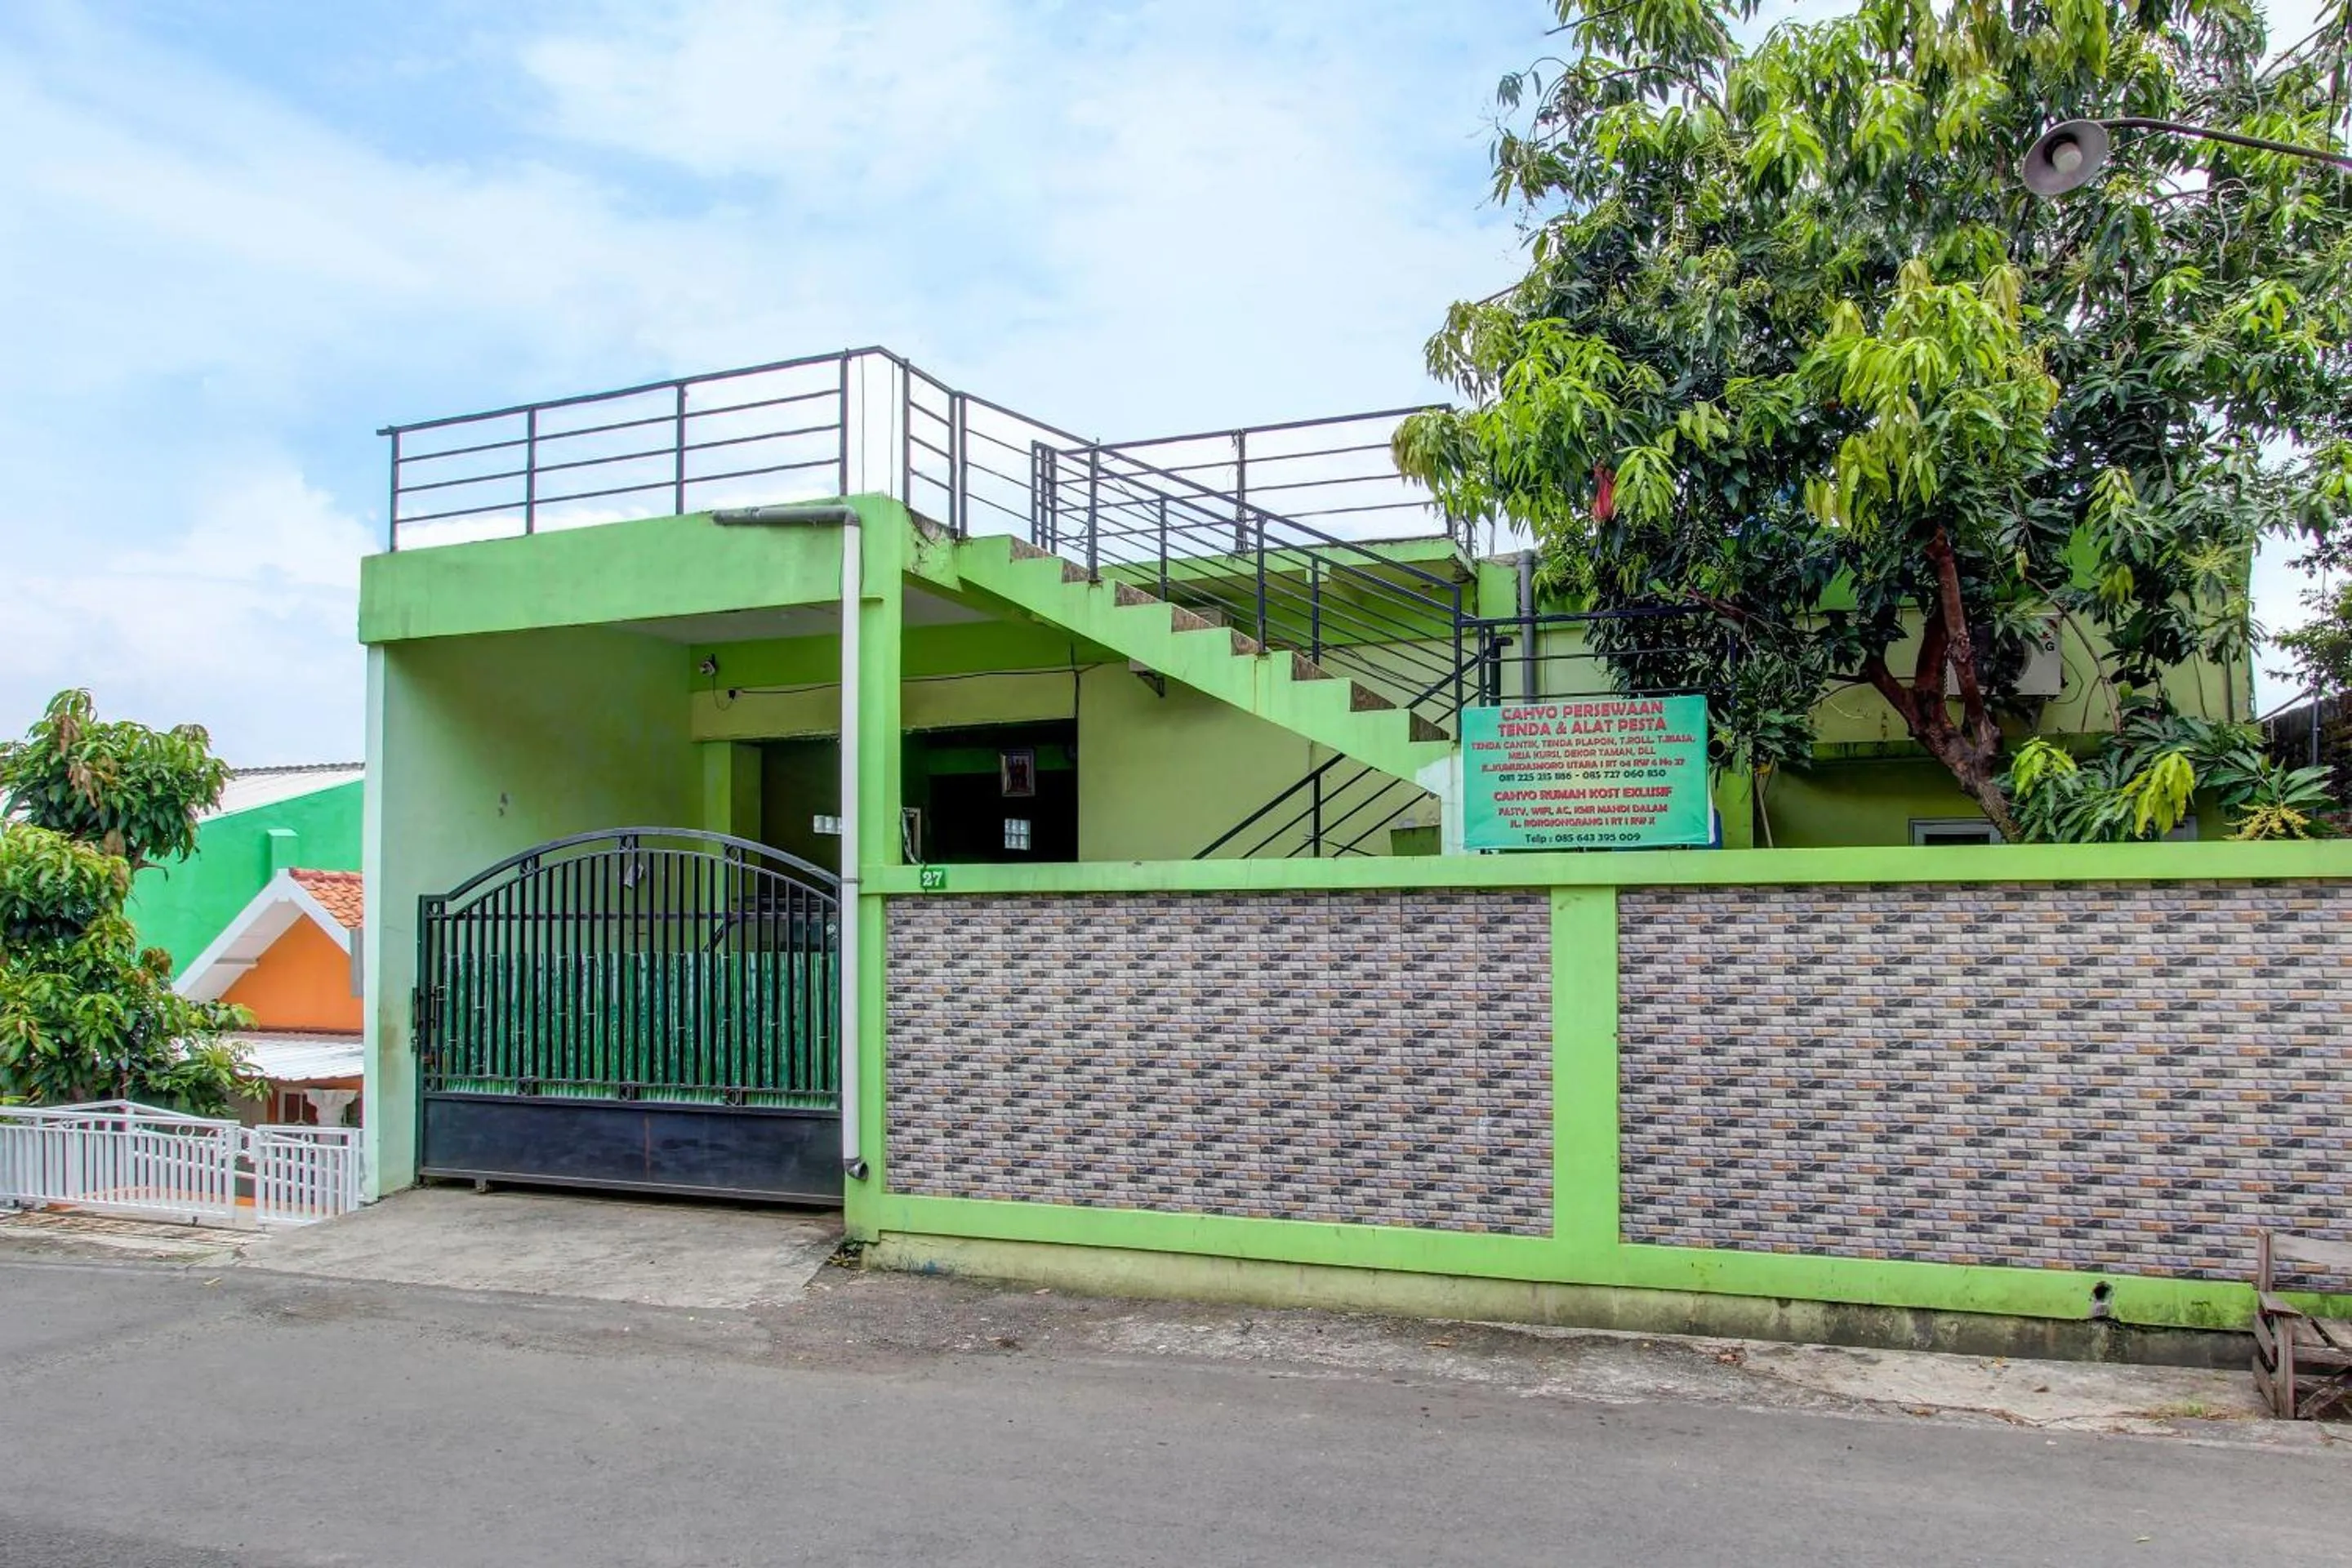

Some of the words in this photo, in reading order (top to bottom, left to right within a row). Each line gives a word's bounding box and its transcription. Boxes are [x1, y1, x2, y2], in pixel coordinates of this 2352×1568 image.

[1502, 705, 1557, 720] CAHYO
[1563, 701, 1664, 718] PERSEWAAN
[1498, 722, 1551, 737] TENDA
[1556, 721, 1567, 734] &
[1571, 719, 1613, 734] ALAT
[1618, 717, 1666, 733] PESTA
[1472, 742, 1501, 750] TENDA
[1541, 739, 1573, 747] TENDA
[1508, 751, 1531, 760] MEJA
[1564, 749, 1597, 758] DEKOR
[1638, 746, 1656, 755] DLL
[1566, 760, 1598, 769] UTARA
[1606, 760, 1617, 768] RT
[1633, 759, 1650, 767] RW
[1659, 757, 1673, 766] No
[1674, 758, 1686, 766] 27
[1517, 773, 1535, 782] 225
[1582, 771, 1601, 780] 085
[1604, 770, 1621, 778] 727
[1624, 769, 1645, 778] 060
[1494, 791, 1538, 801] CAHYO
[1539, 789, 1586, 800] RUMAH
[1589, 788, 1620, 799] KOST
[1623, 786, 1673, 797] EKLUSIF
[1597, 804, 1631, 813] MANDI
[1633, 804, 1668, 813] DALAM
[1610, 817, 1623, 826] RT
[1526, 834, 1547, 844] Telp
[1555, 834, 1574, 843] 085
[1577, 833, 1596, 842] 643
[1597, 833, 1616, 841] 395
[1619, 832, 1641, 841] 009
[923, 871, 942, 887] 27
